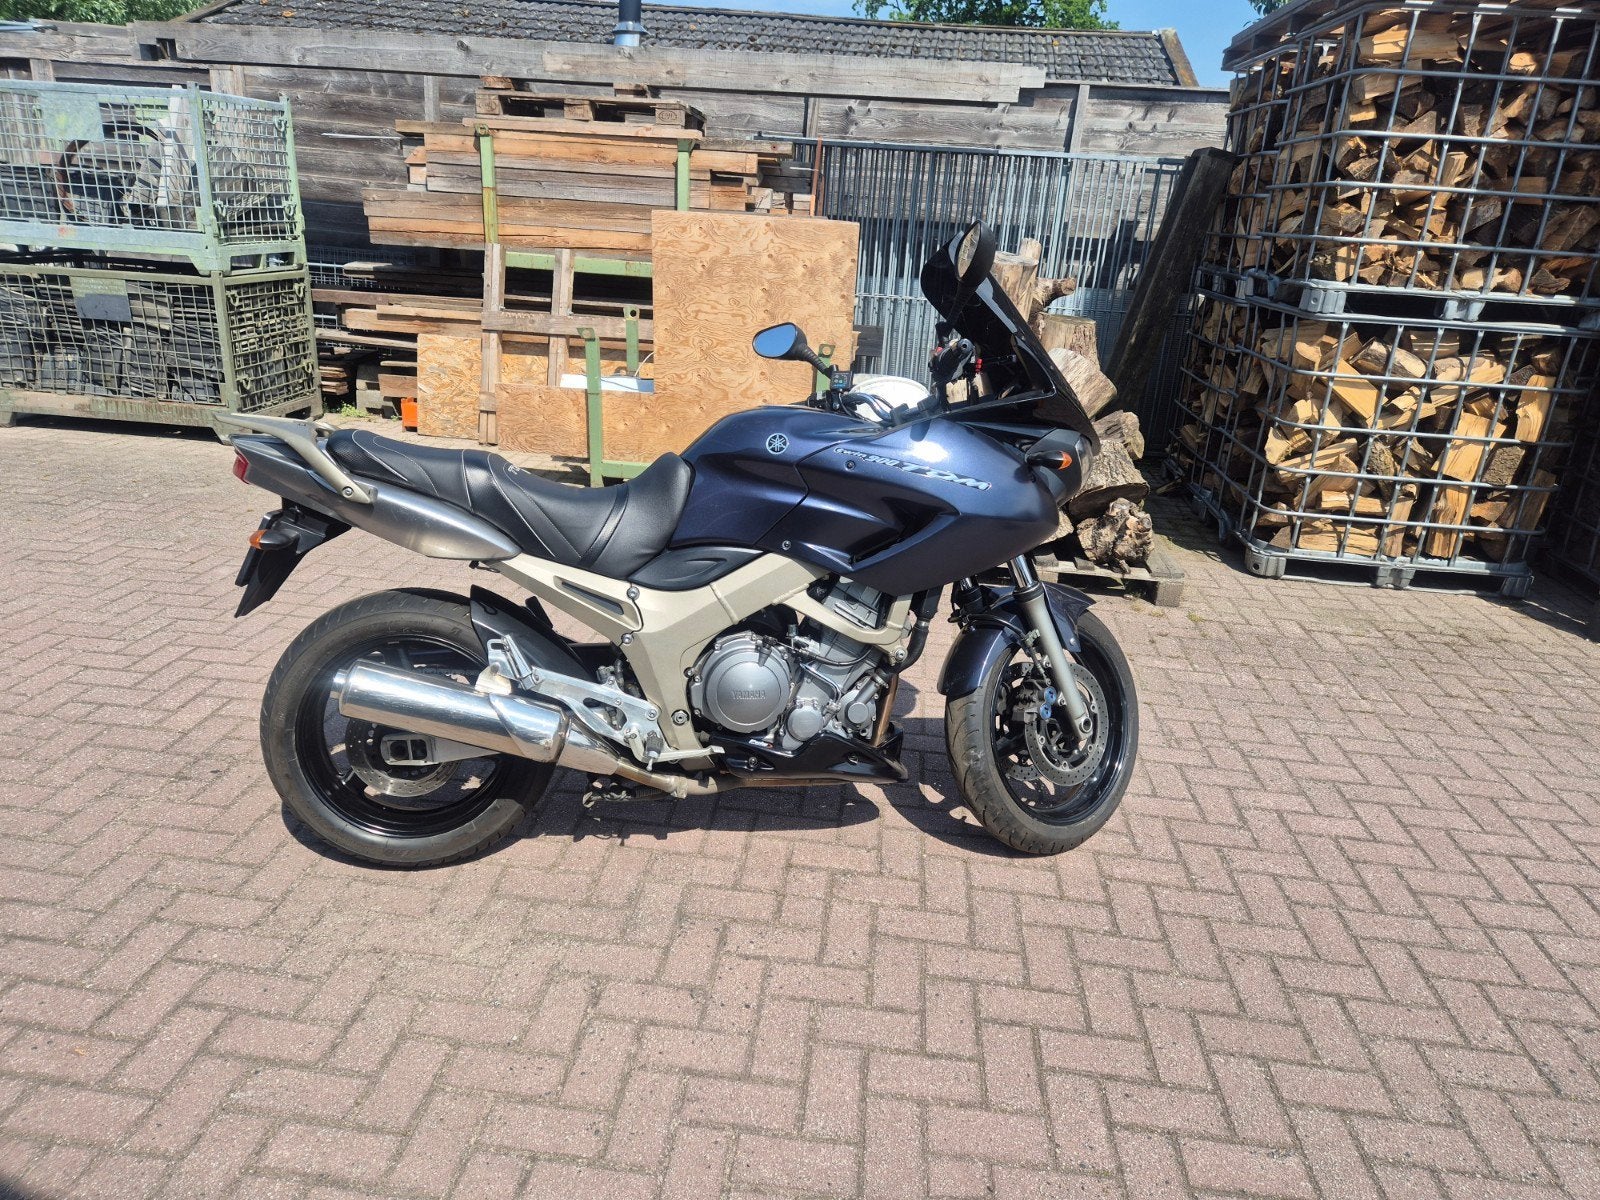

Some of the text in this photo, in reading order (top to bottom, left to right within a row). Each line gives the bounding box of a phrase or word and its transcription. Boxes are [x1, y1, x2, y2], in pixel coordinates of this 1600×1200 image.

[865, 455, 899, 467] 900
[899, 462, 992, 491] TDM
[731, 689, 766, 700] YAMAHA
